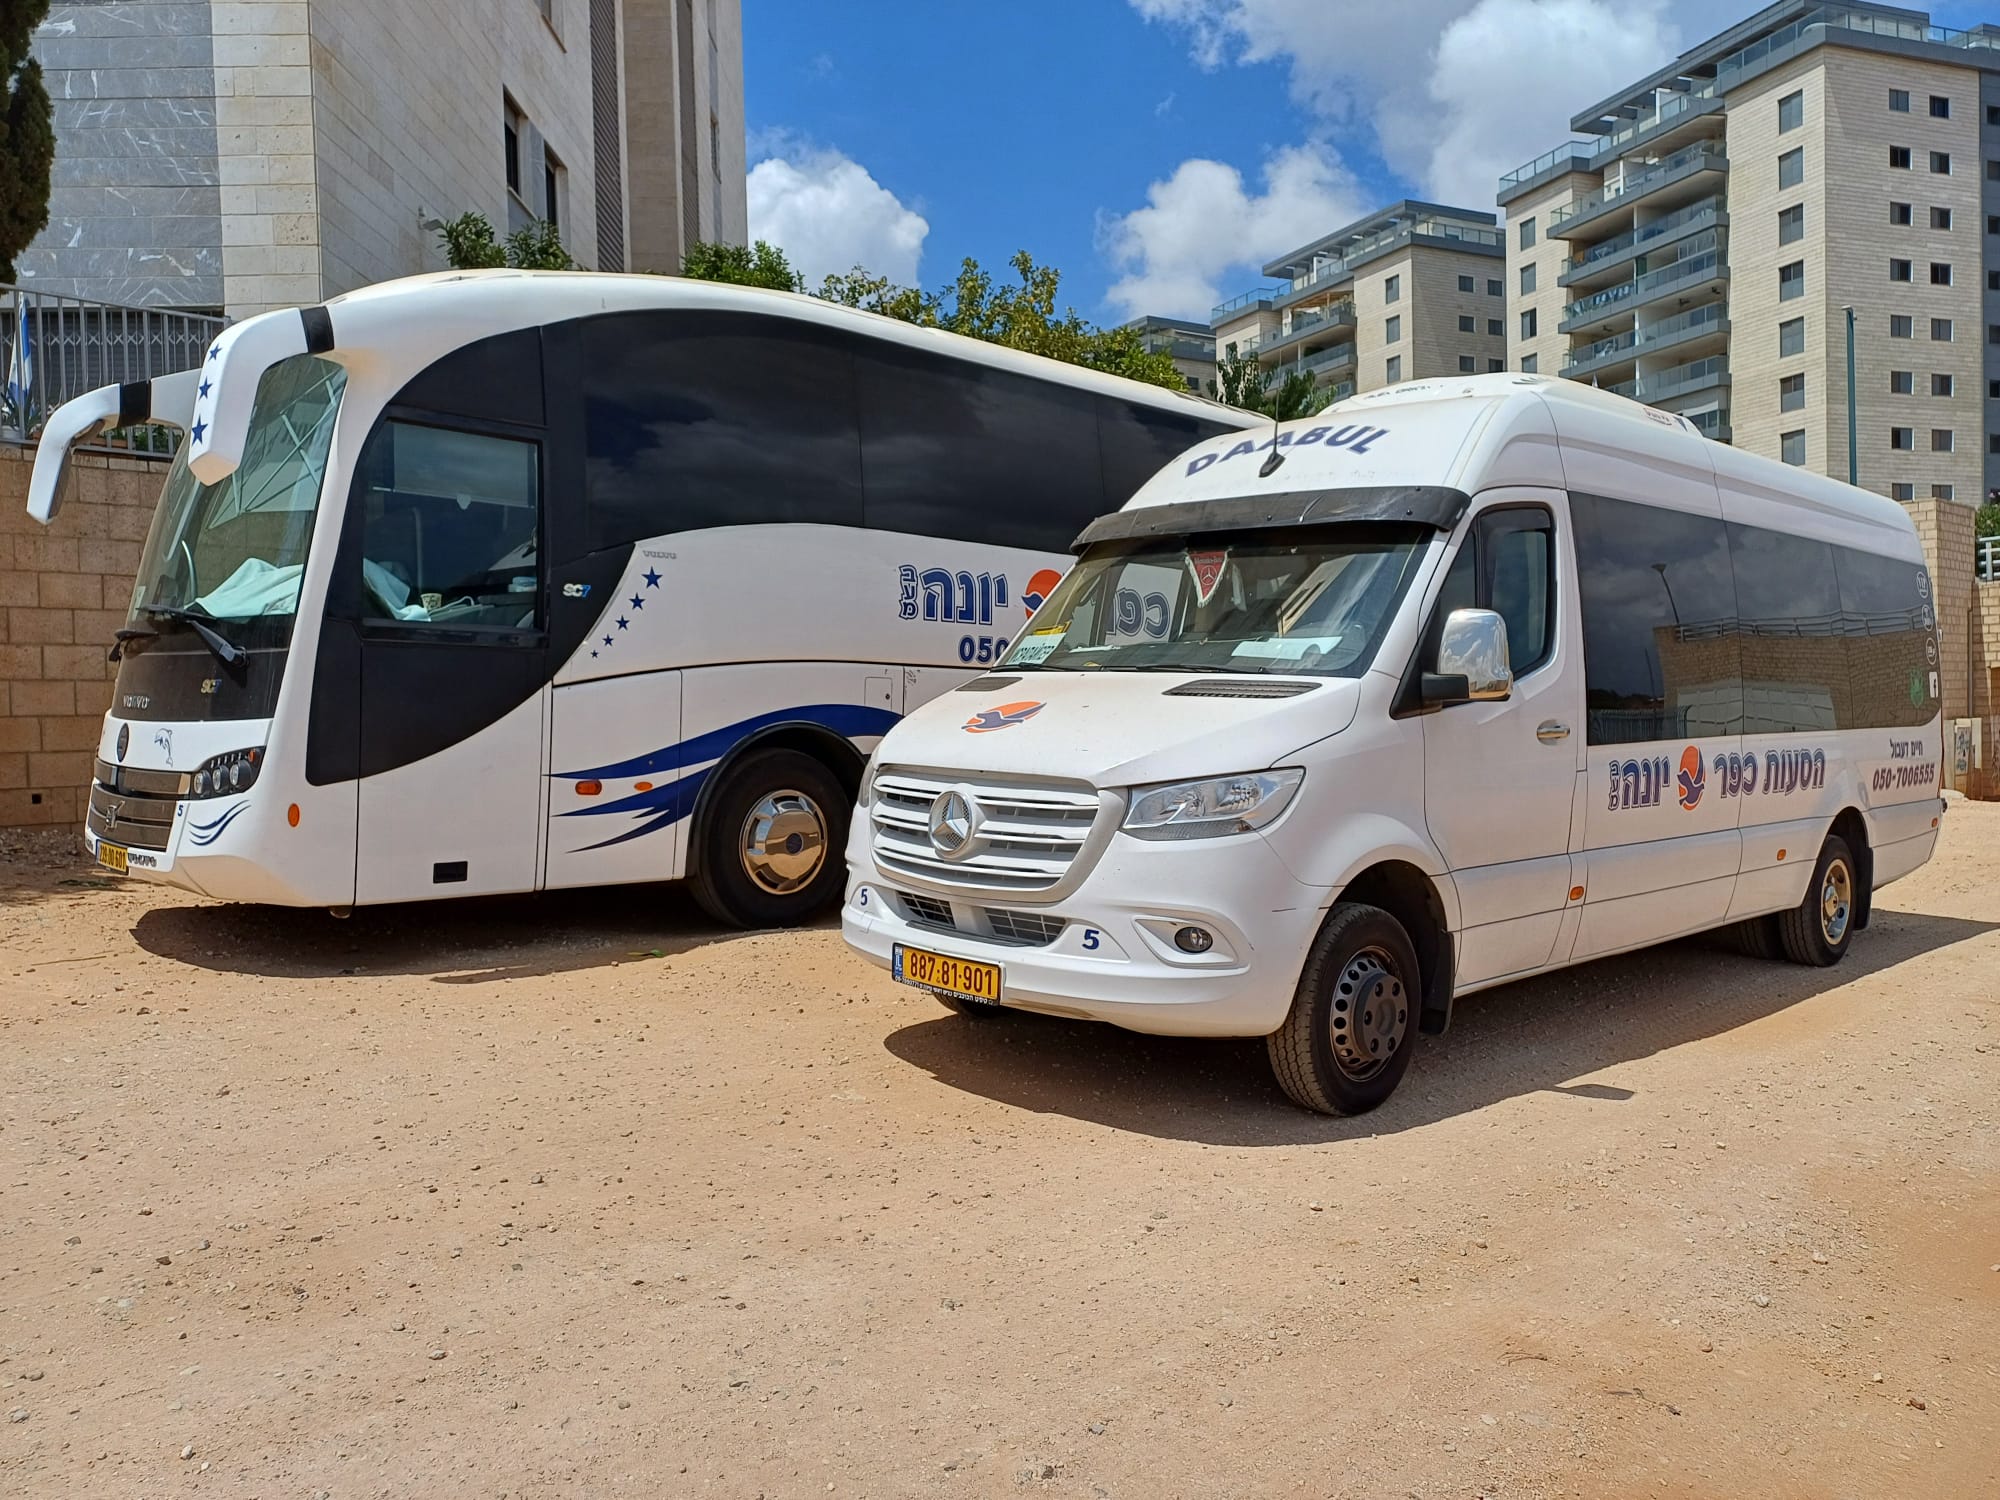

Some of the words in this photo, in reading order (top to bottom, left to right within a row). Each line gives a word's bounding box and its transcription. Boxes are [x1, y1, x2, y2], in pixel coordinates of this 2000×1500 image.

[1185, 425, 1390, 477] DAABUL
[562, 583, 591, 597] SC7
[919, 567, 1009, 625] יונה
[200, 679, 222, 694] SC7
[1889, 738, 1909, 759] דעבול
[1910, 740, 1923, 757] חיים
[1620, 755, 1670, 809] יונה
[1713, 751, 1758, 798] כפר
[1762, 747, 1825, 796] הסעות
[1873, 762, 1935, 791] 050-7006555
[177, 804, 184, 817] 5
[860, 888, 869, 906] 5
[1082, 928, 1100, 950] 5
